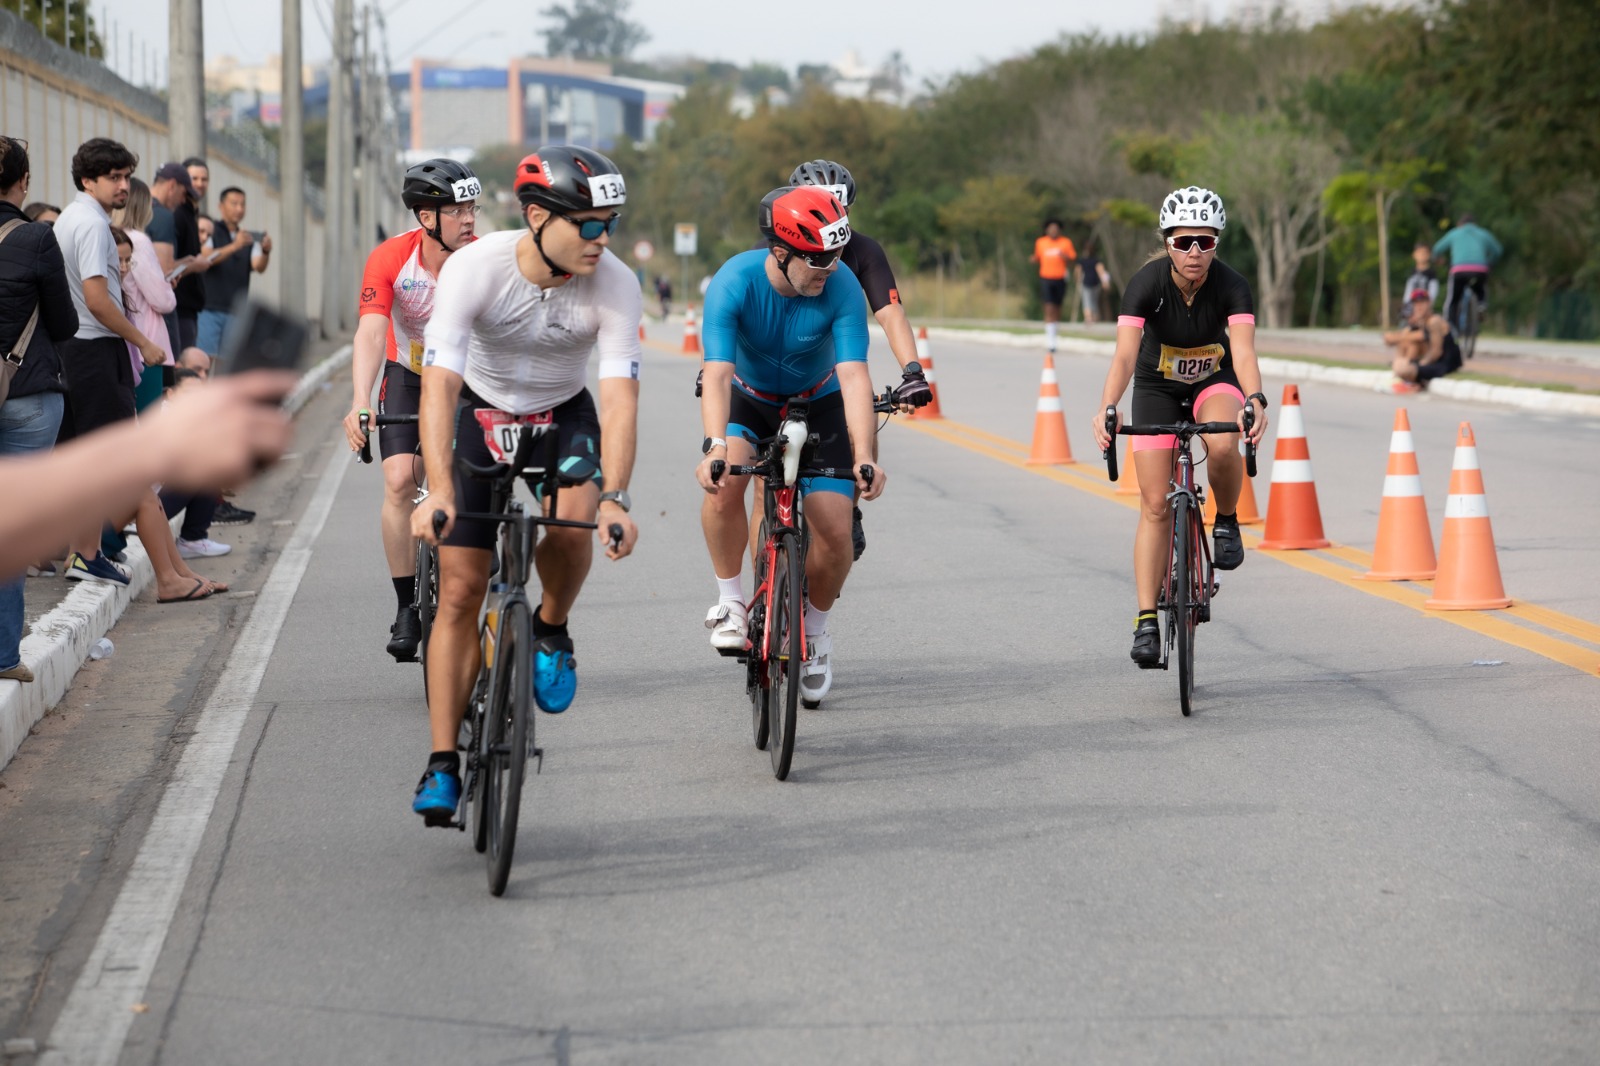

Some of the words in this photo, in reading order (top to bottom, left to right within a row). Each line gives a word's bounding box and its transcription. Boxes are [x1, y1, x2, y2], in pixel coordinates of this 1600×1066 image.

[457, 182, 481, 199] 269
[1178, 208, 1209, 222] 216
[775, 222, 801, 240] GIRO
[1177, 357, 1213, 376] 0216
